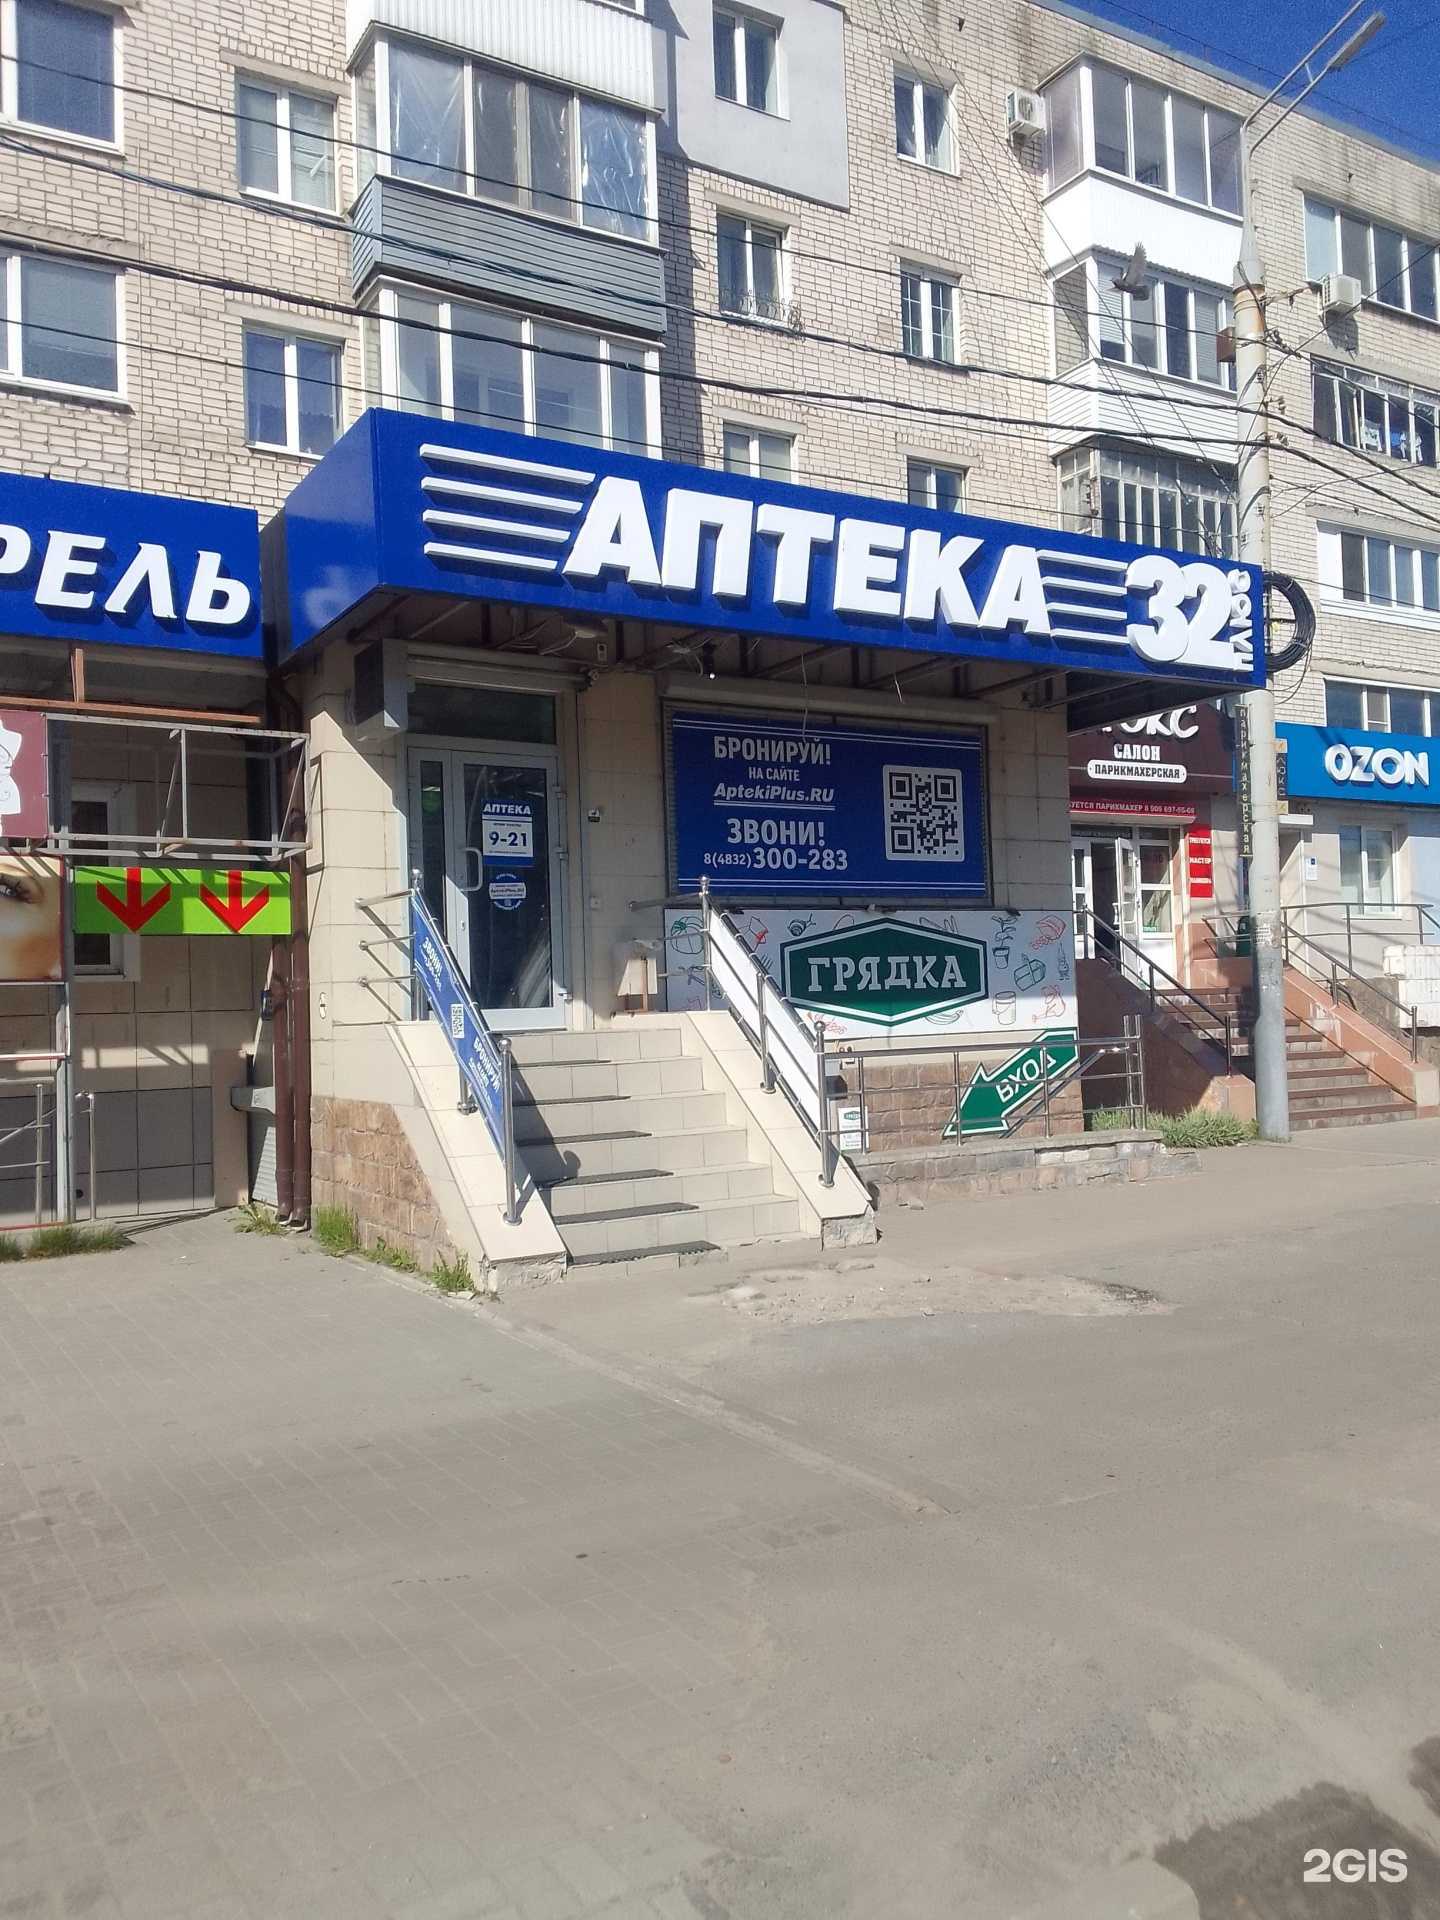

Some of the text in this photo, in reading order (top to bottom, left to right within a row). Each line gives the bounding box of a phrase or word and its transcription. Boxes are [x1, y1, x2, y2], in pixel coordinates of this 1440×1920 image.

[562, 476, 1234, 669] АПТЕКА 32
[1228, 569, 1254, 671] ПЛЮС
[714, 736, 831, 765] БРОНИРУЙ!
[1114, 744, 1161, 761] САЛОН
[749, 766, 800, 781] НА САЙТЕ
[1095, 764, 1180, 779] ПАРИКМАХЕРСКАЯ
[1325, 744, 1429, 785] OZON
[714, 783, 834, 802] AptekiPlus.RU
[483, 803, 531, 815] АПТЕКА
[489, 831, 527, 846] 9-21
[727, 818, 825, 846] ЗВОНИ!
[704, 847, 848, 870] 8(4832)300-283
[808, 955, 967, 992] ГРЯДКА
